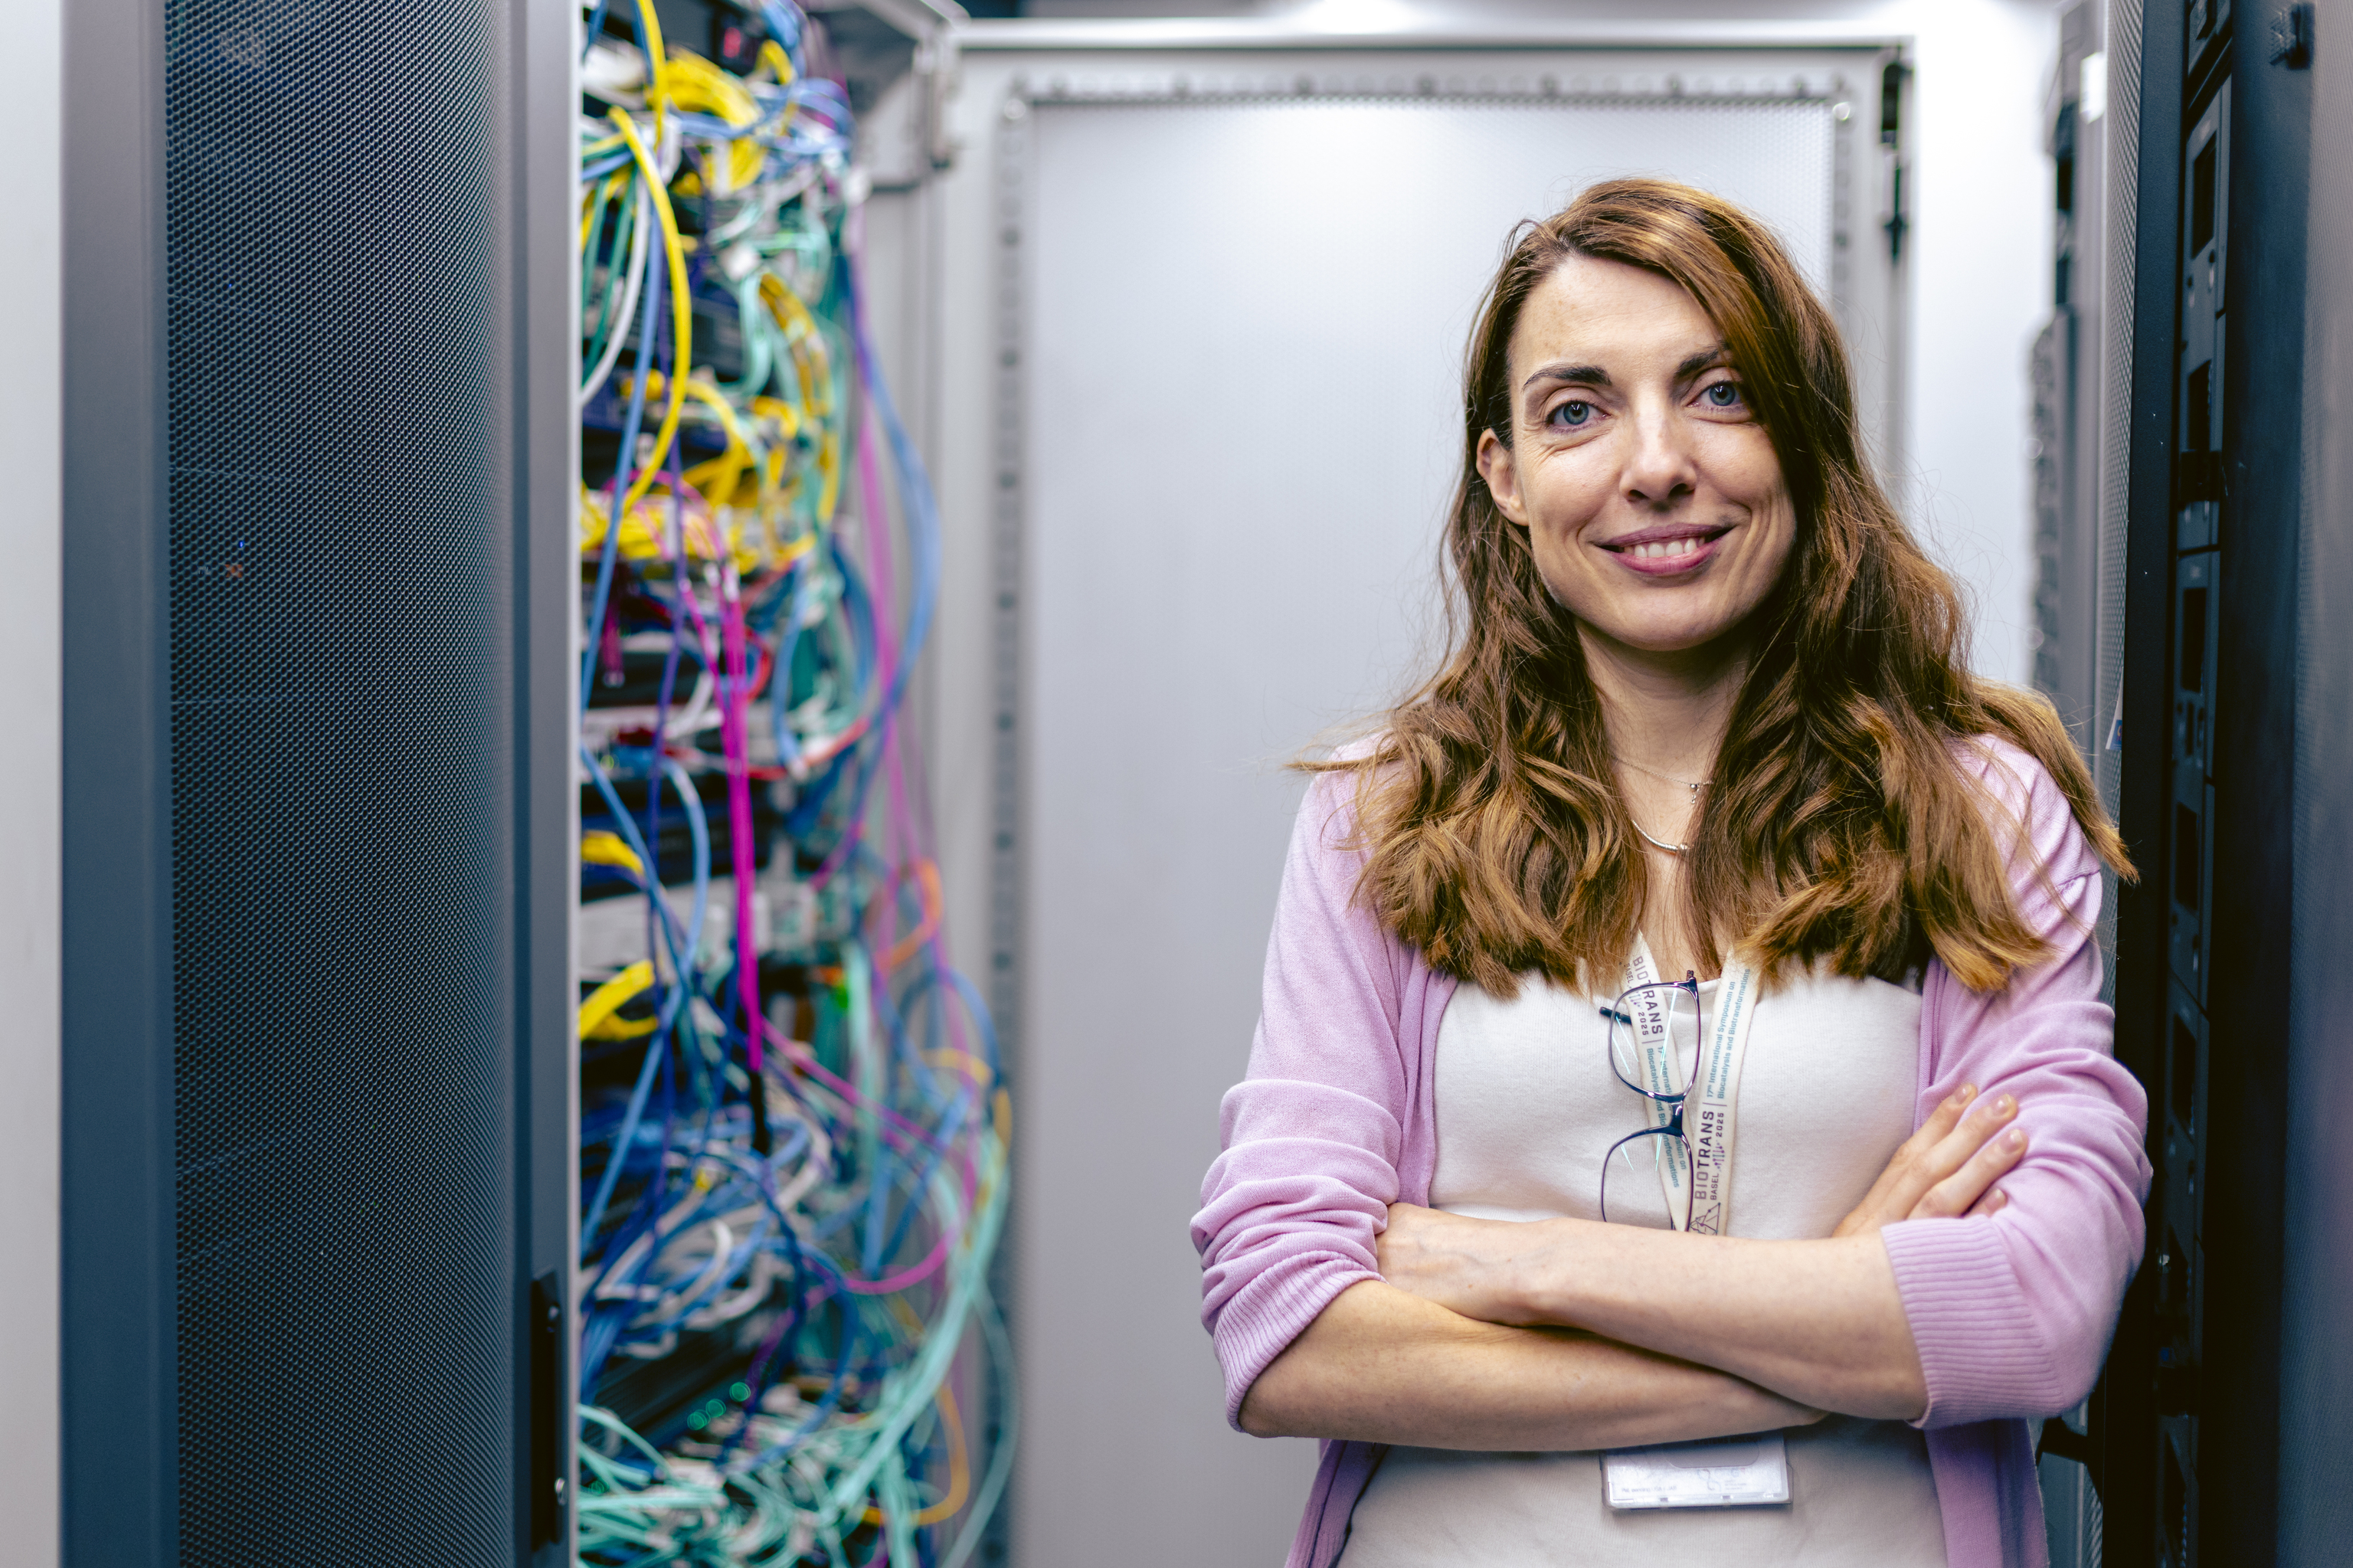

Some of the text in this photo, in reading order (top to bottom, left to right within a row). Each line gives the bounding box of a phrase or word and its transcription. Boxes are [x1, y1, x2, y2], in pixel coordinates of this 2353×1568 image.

[1633, 956, 1664, 1034] BIOTRANS
[1638, 1012, 1649, 1036] 2025
[1709, 1034, 1723, 1083] International
[1717, 991, 1733, 1033] Symposium
[1729, 981, 1736, 990] on
[1717, 1052, 1730, 1098] Biocatalysis
[1728, 969, 1750, 1035] Biotransformations
[1655, 1098, 1664, 1111] nd
[1694, 1111, 1714, 1200] BIOTRANS
[1710, 1112, 1724, 1200] BASEL 2025
